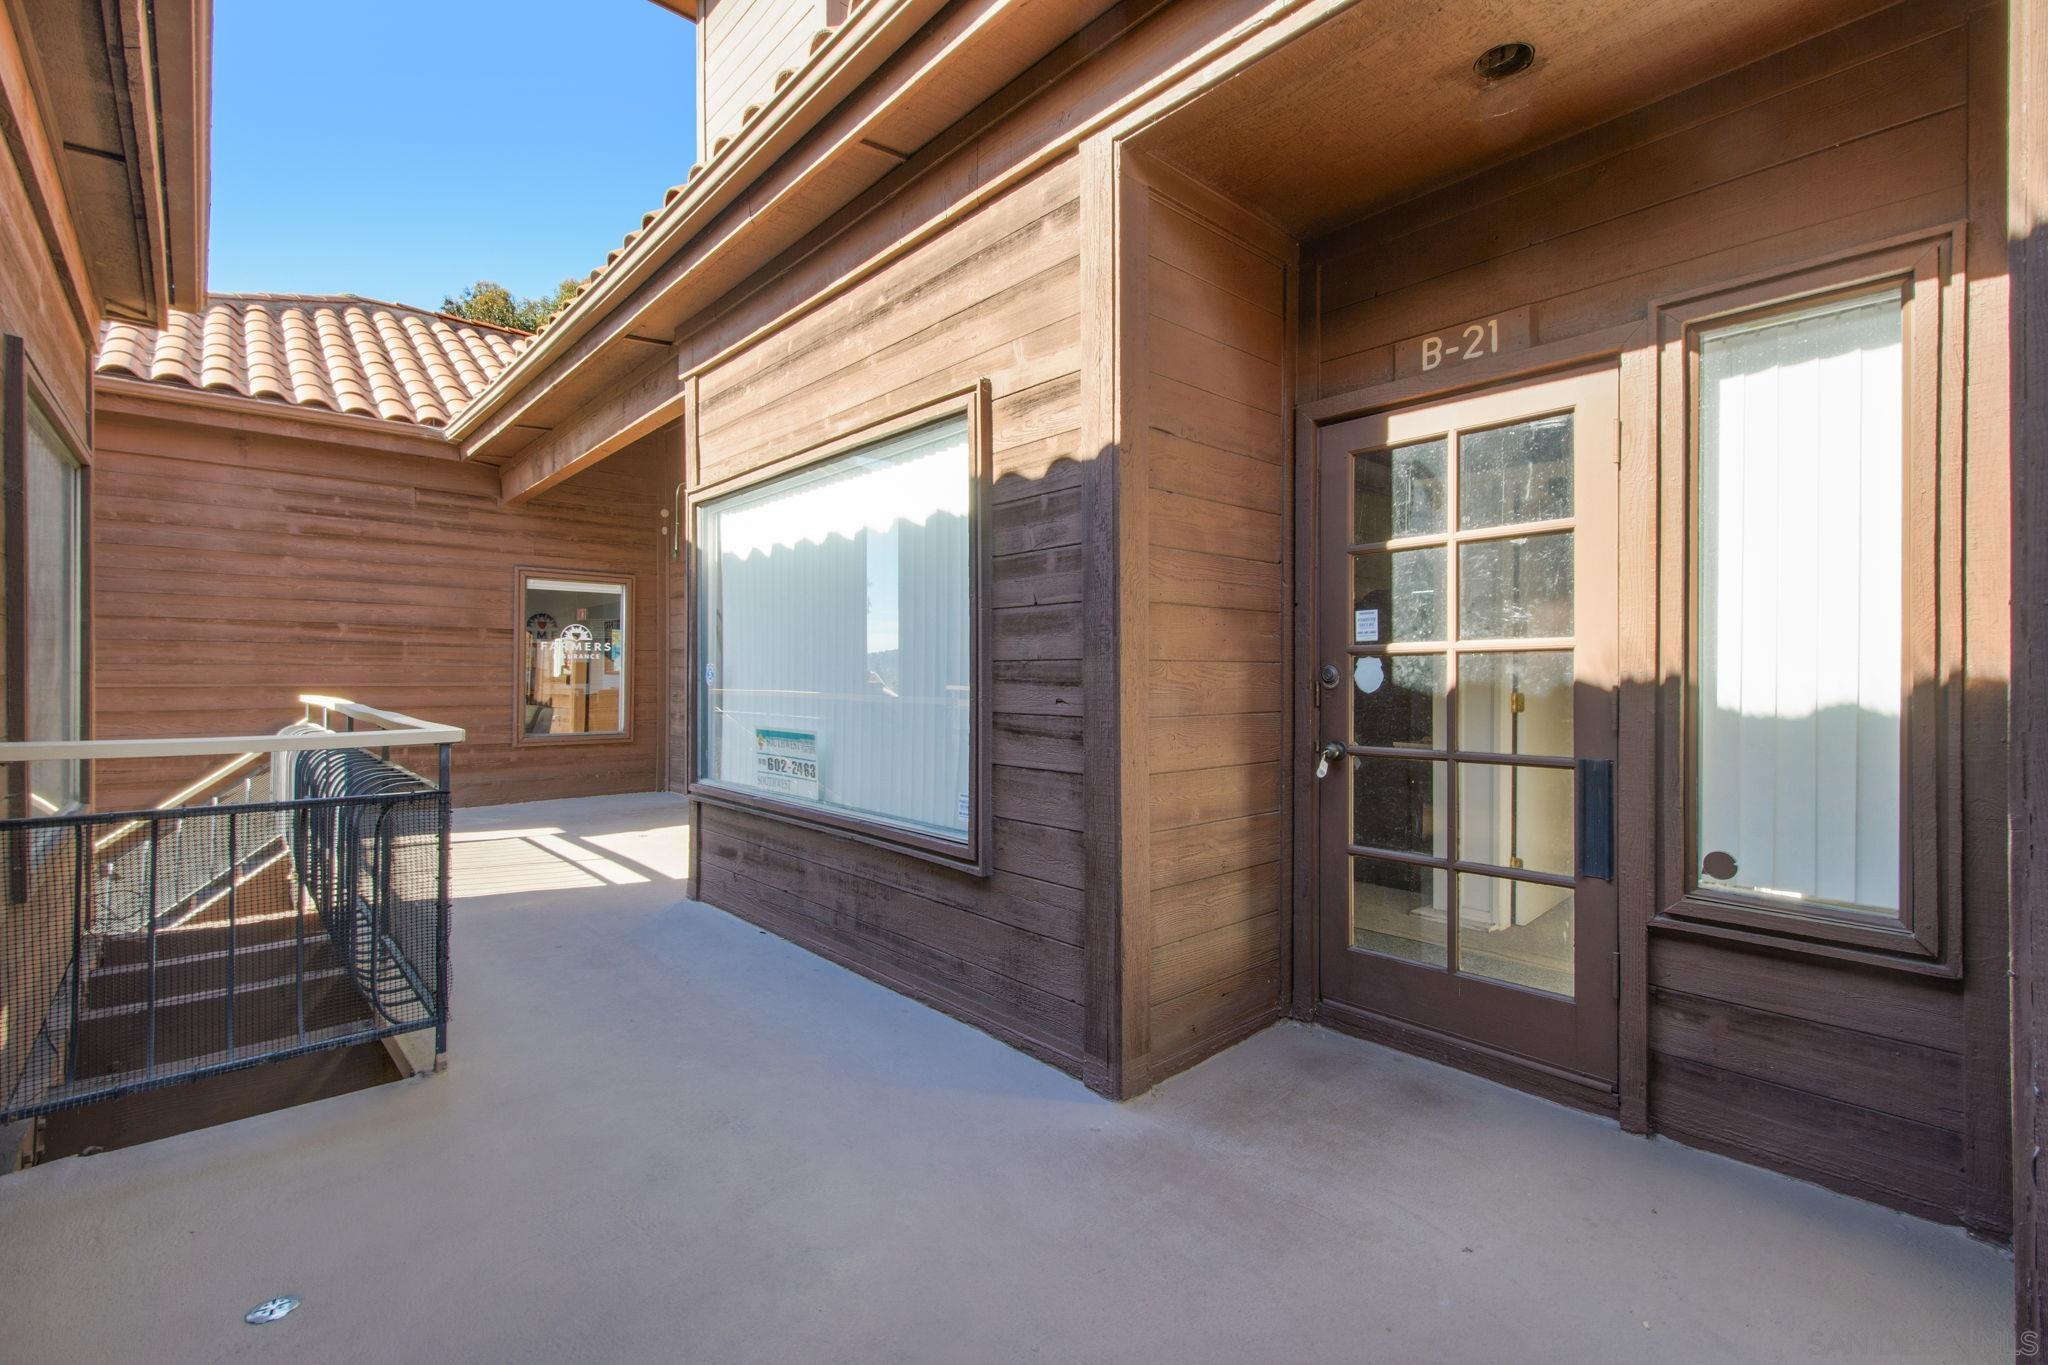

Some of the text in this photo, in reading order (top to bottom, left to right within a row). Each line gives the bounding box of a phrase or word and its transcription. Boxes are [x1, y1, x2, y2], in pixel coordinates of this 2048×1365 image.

[1422, 319, 1498, 372] B-21
[540, 641, 612, 652] FARMERS
[767, 757, 816, 779] 602-2463
